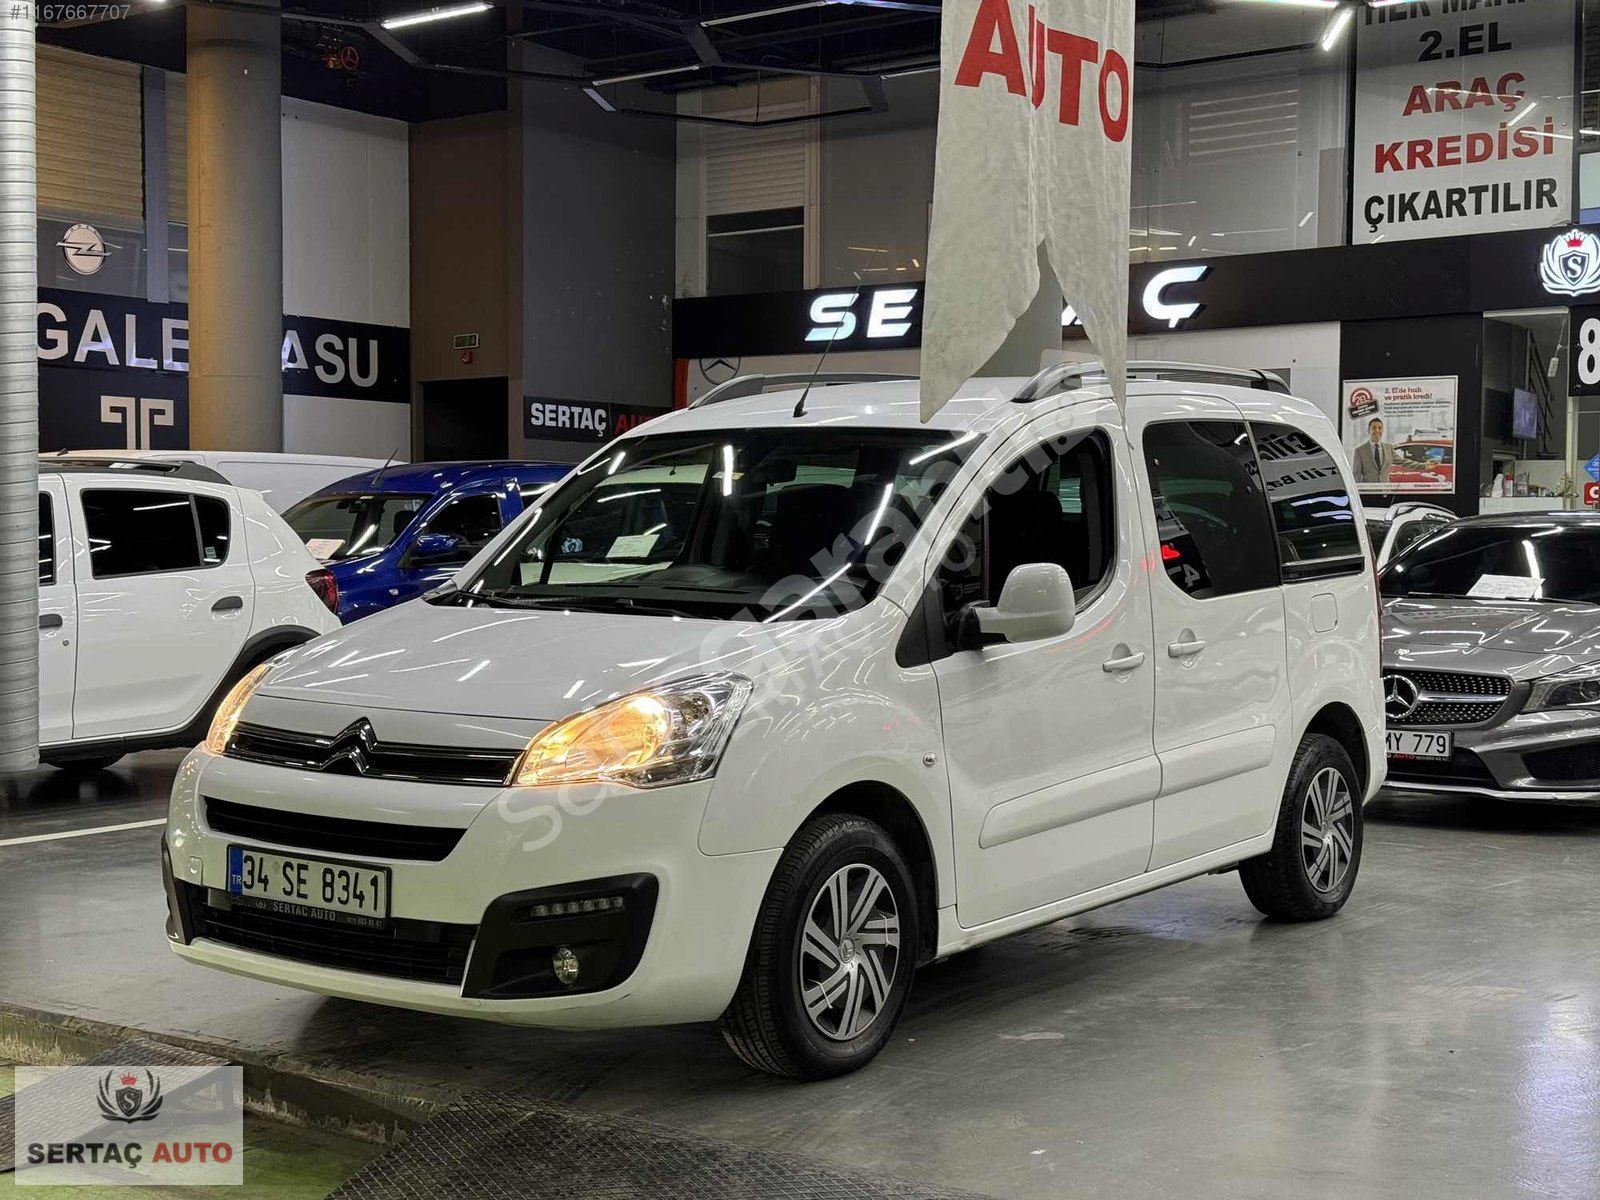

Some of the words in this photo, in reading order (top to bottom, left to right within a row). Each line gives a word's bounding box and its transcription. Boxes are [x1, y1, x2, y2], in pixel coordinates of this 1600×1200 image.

[1418, 22, 1512, 61] 2.EL
[1403, 72, 1525, 116] ARAÇ
[1375, 117, 1553, 173] KREDİSİ
[1364, 178, 1558, 233] ÇIKARTILIR
[531, 403, 607, 437] SERTAÇ
[1413, 734, 1446, 754] 779
[231, 874, 242, 885] TR
[243, 855, 269, 892] 34
[282, 861, 309, 899] SE
[322, 867, 378, 911] 8341
